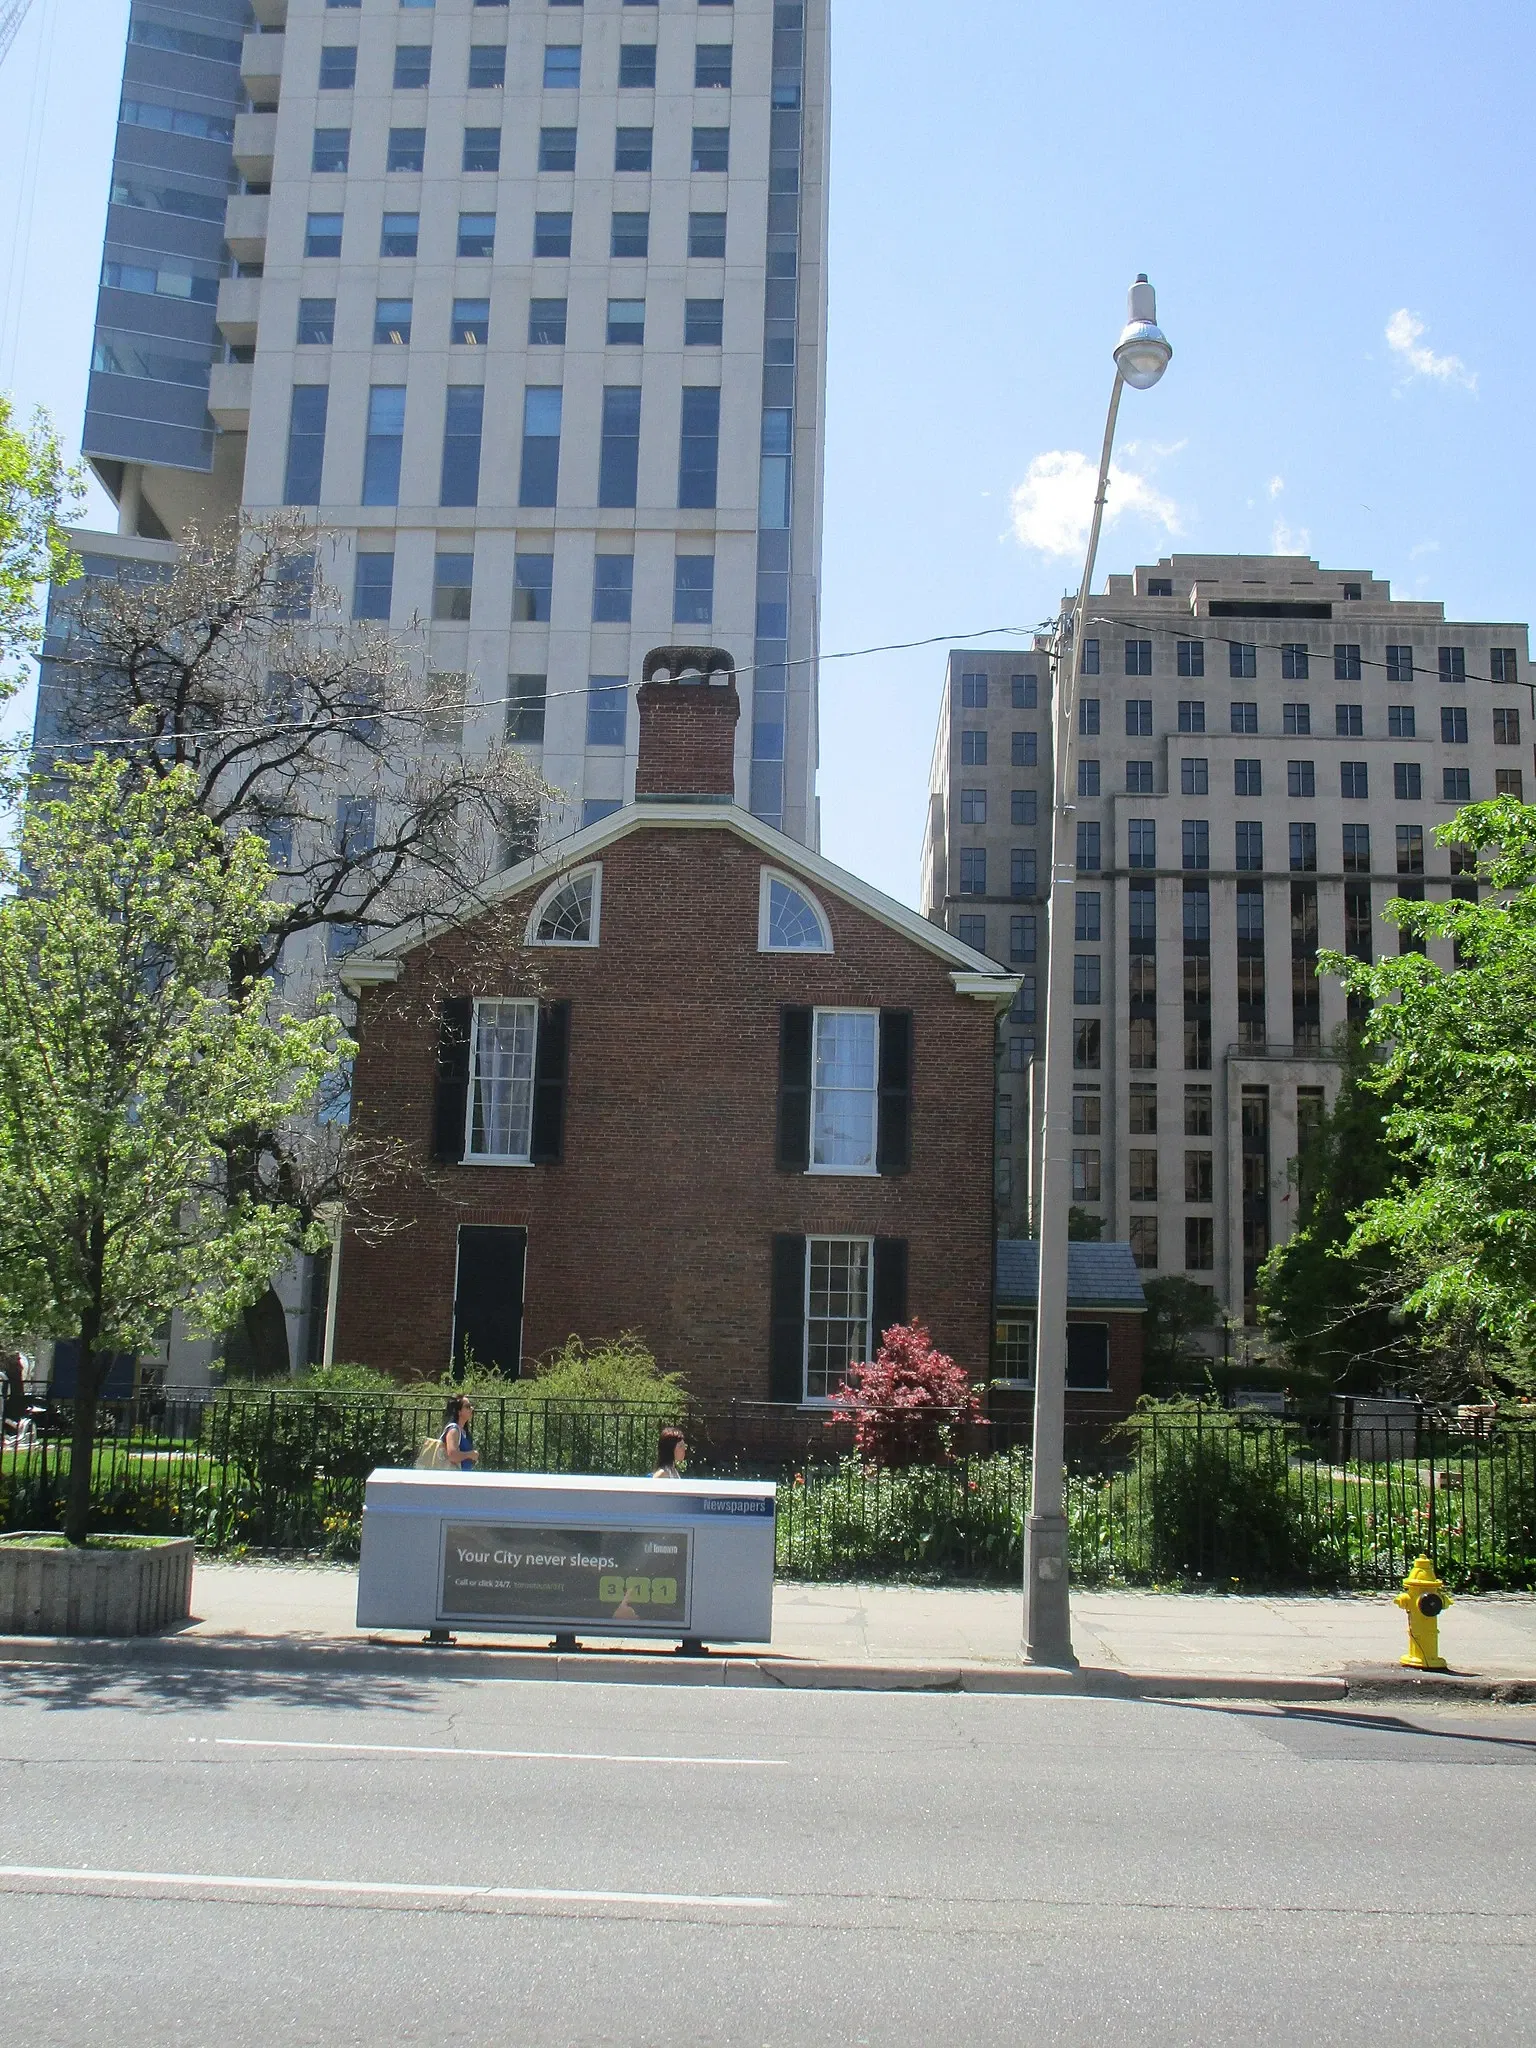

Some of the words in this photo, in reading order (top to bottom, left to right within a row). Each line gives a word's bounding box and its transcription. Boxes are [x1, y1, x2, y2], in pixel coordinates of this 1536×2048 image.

[703, 1499, 766, 1514] Newspapers
[456, 1548, 490, 1563] Your
[494, 1550, 523, 1567] City
[526, 1554, 567, 1566] never
[570, 1553, 619, 1571] sleeps.
[454, 1578, 469, 1586] Call
[478, 1578, 494, 1588] click
